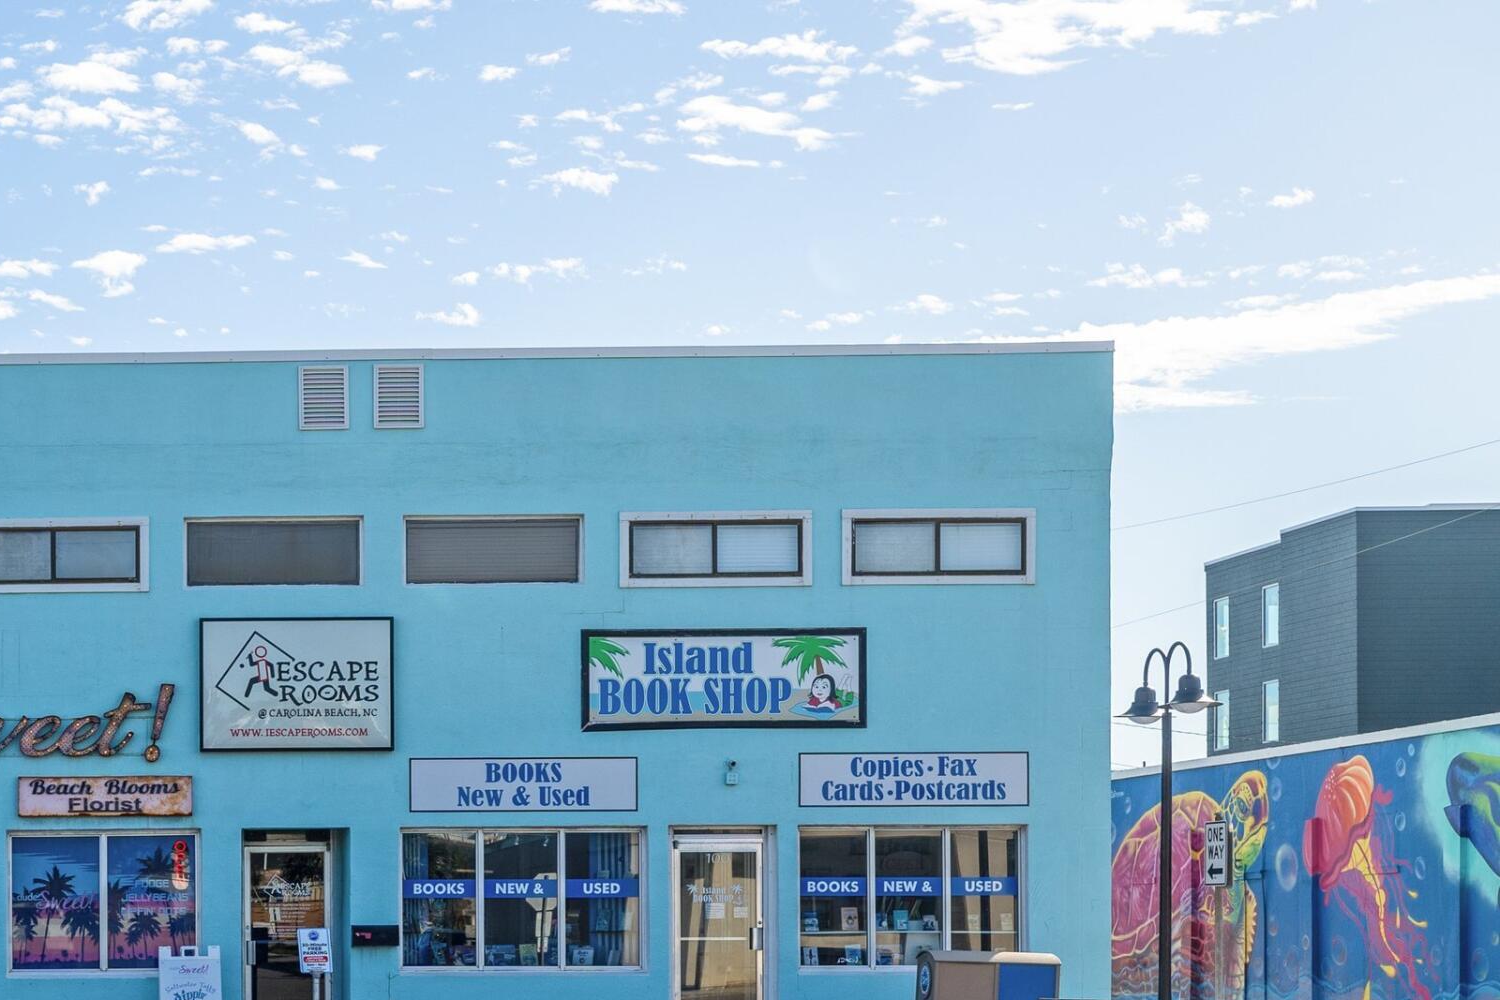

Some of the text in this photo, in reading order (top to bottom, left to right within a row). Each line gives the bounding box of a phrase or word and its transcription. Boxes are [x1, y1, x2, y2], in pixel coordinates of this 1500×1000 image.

[643, 641, 753, 675] Island
[279, 684, 380, 706] ROOMS
[598, 677, 791, 715] BOOK SHOP
[269, 708, 322, 719] CAROLINA
[324, 708, 360, 718] BEACH,
[362, 708, 378, 717] NC
[485, 762, 562, 783] BOOKS
[850, 756, 978, 780] Copies Fax
[29, 779, 180, 796] Beach Blooms
[822, 780, 1006, 801] Cards Postcards
[68, 797, 142, 812] Florist
[457, 786, 590, 807] New & Used
[1208, 827, 1223, 842] ONE
[1208, 845, 1224, 860] WAY
[135, 880, 169, 888] FUDGE
[412, 883, 621, 895] BOOKS NEW & USED
[806, 881, 1003, 893] BOOKS NEW & USED
